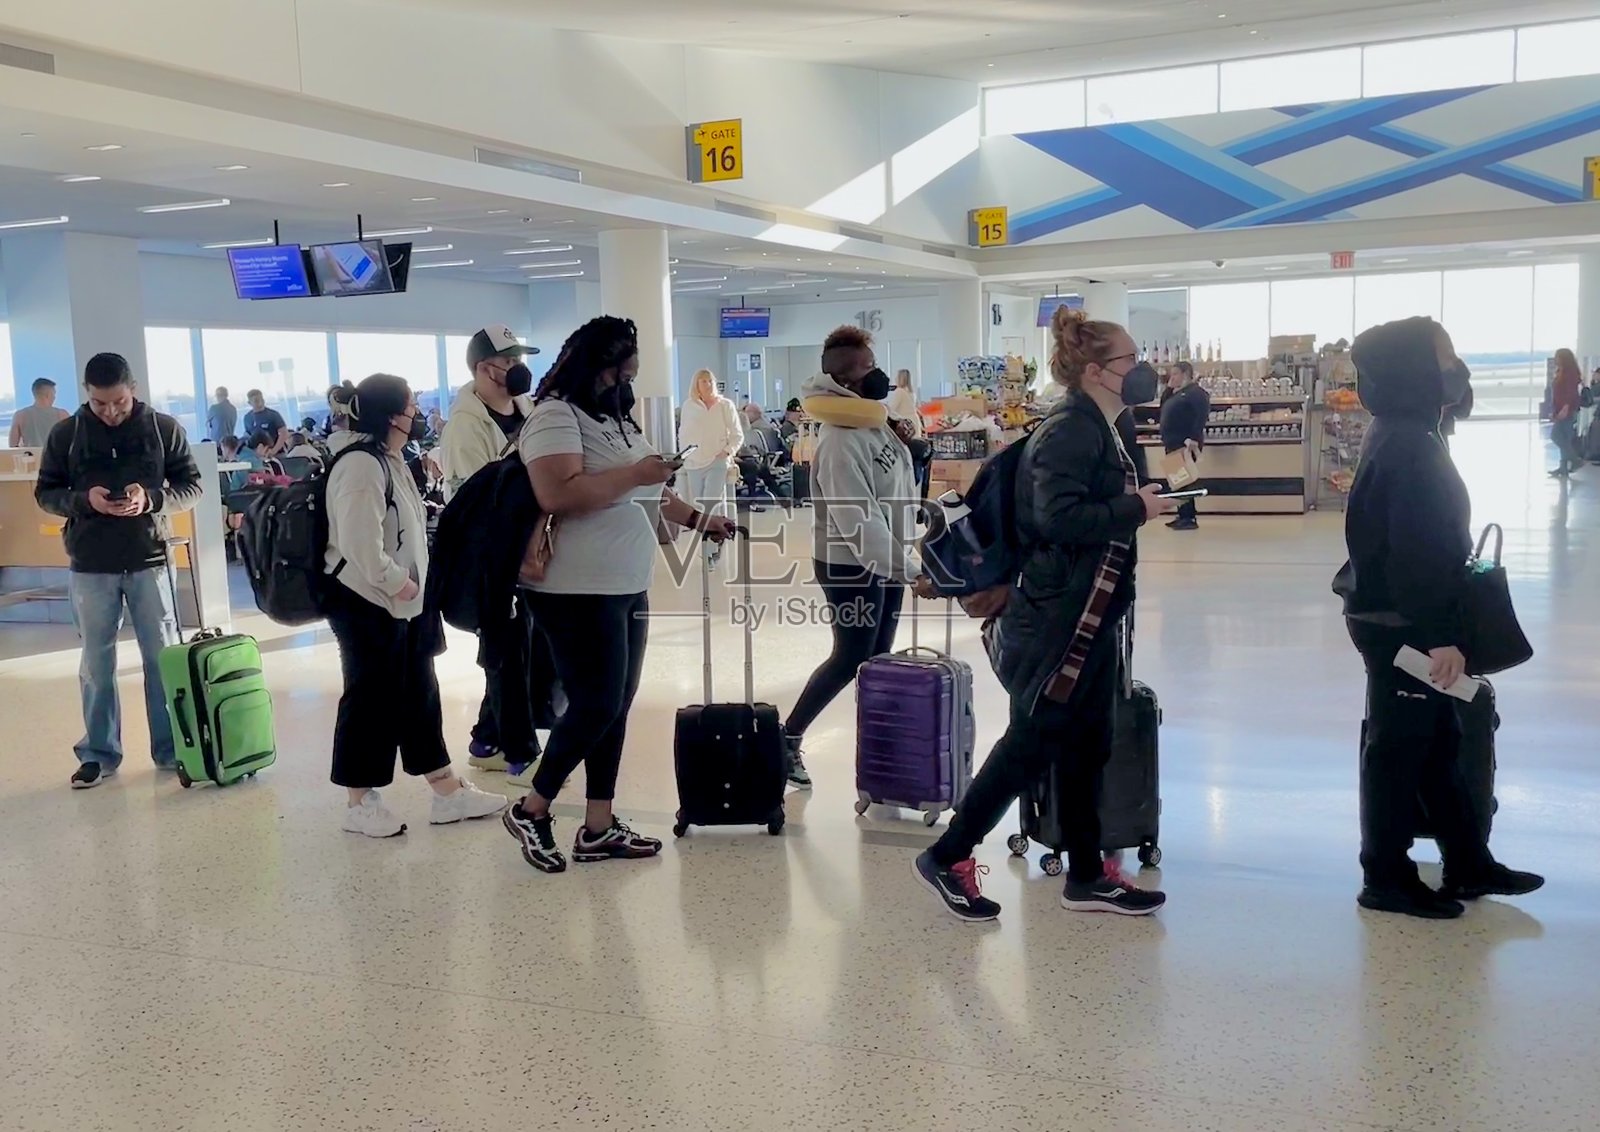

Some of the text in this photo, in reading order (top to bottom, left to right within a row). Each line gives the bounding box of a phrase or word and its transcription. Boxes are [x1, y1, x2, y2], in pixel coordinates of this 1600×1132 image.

[711, 128, 735, 139] GATE
[706, 145, 736, 173] 16
[982, 223, 1002, 240] 15
[1333, 255, 1354, 269] EXIT
[854, 309, 882, 331] 16
